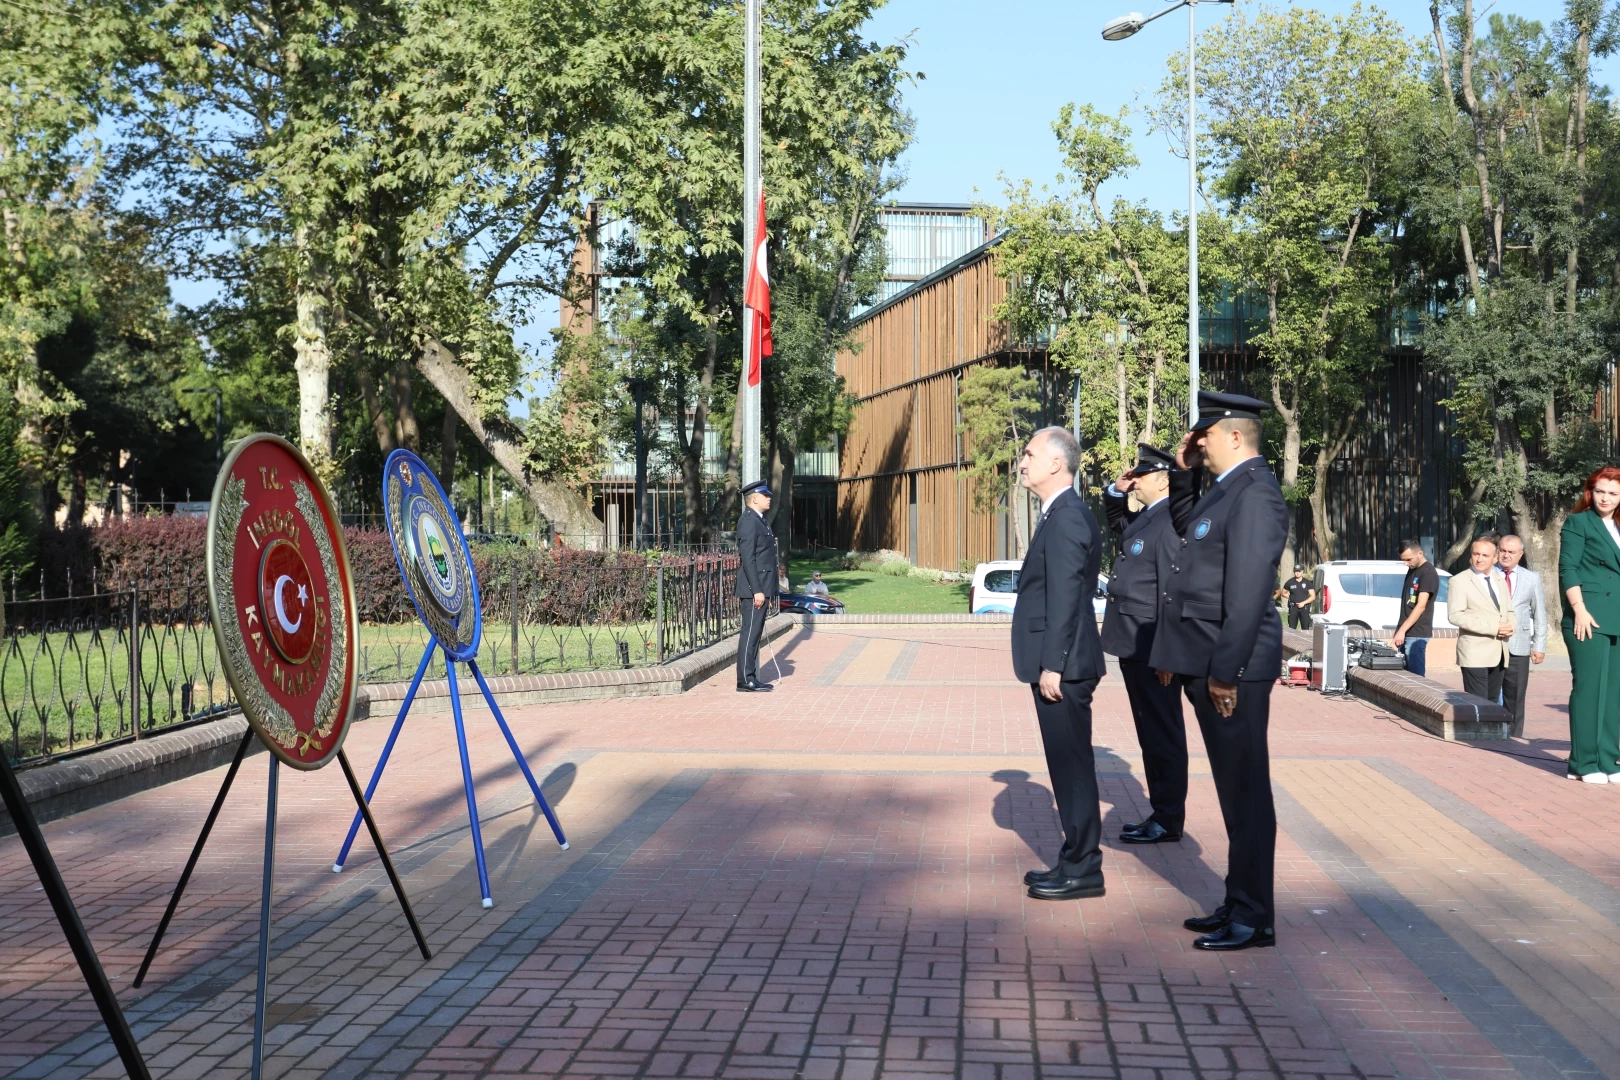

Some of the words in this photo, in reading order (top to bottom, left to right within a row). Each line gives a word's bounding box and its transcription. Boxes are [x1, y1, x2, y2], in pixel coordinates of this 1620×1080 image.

[258, 466, 284, 490] T.C.
[246, 508, 302, 550] İNEGÖL
[244, 595, 327, 697] KAYMAKAMLIĞI
